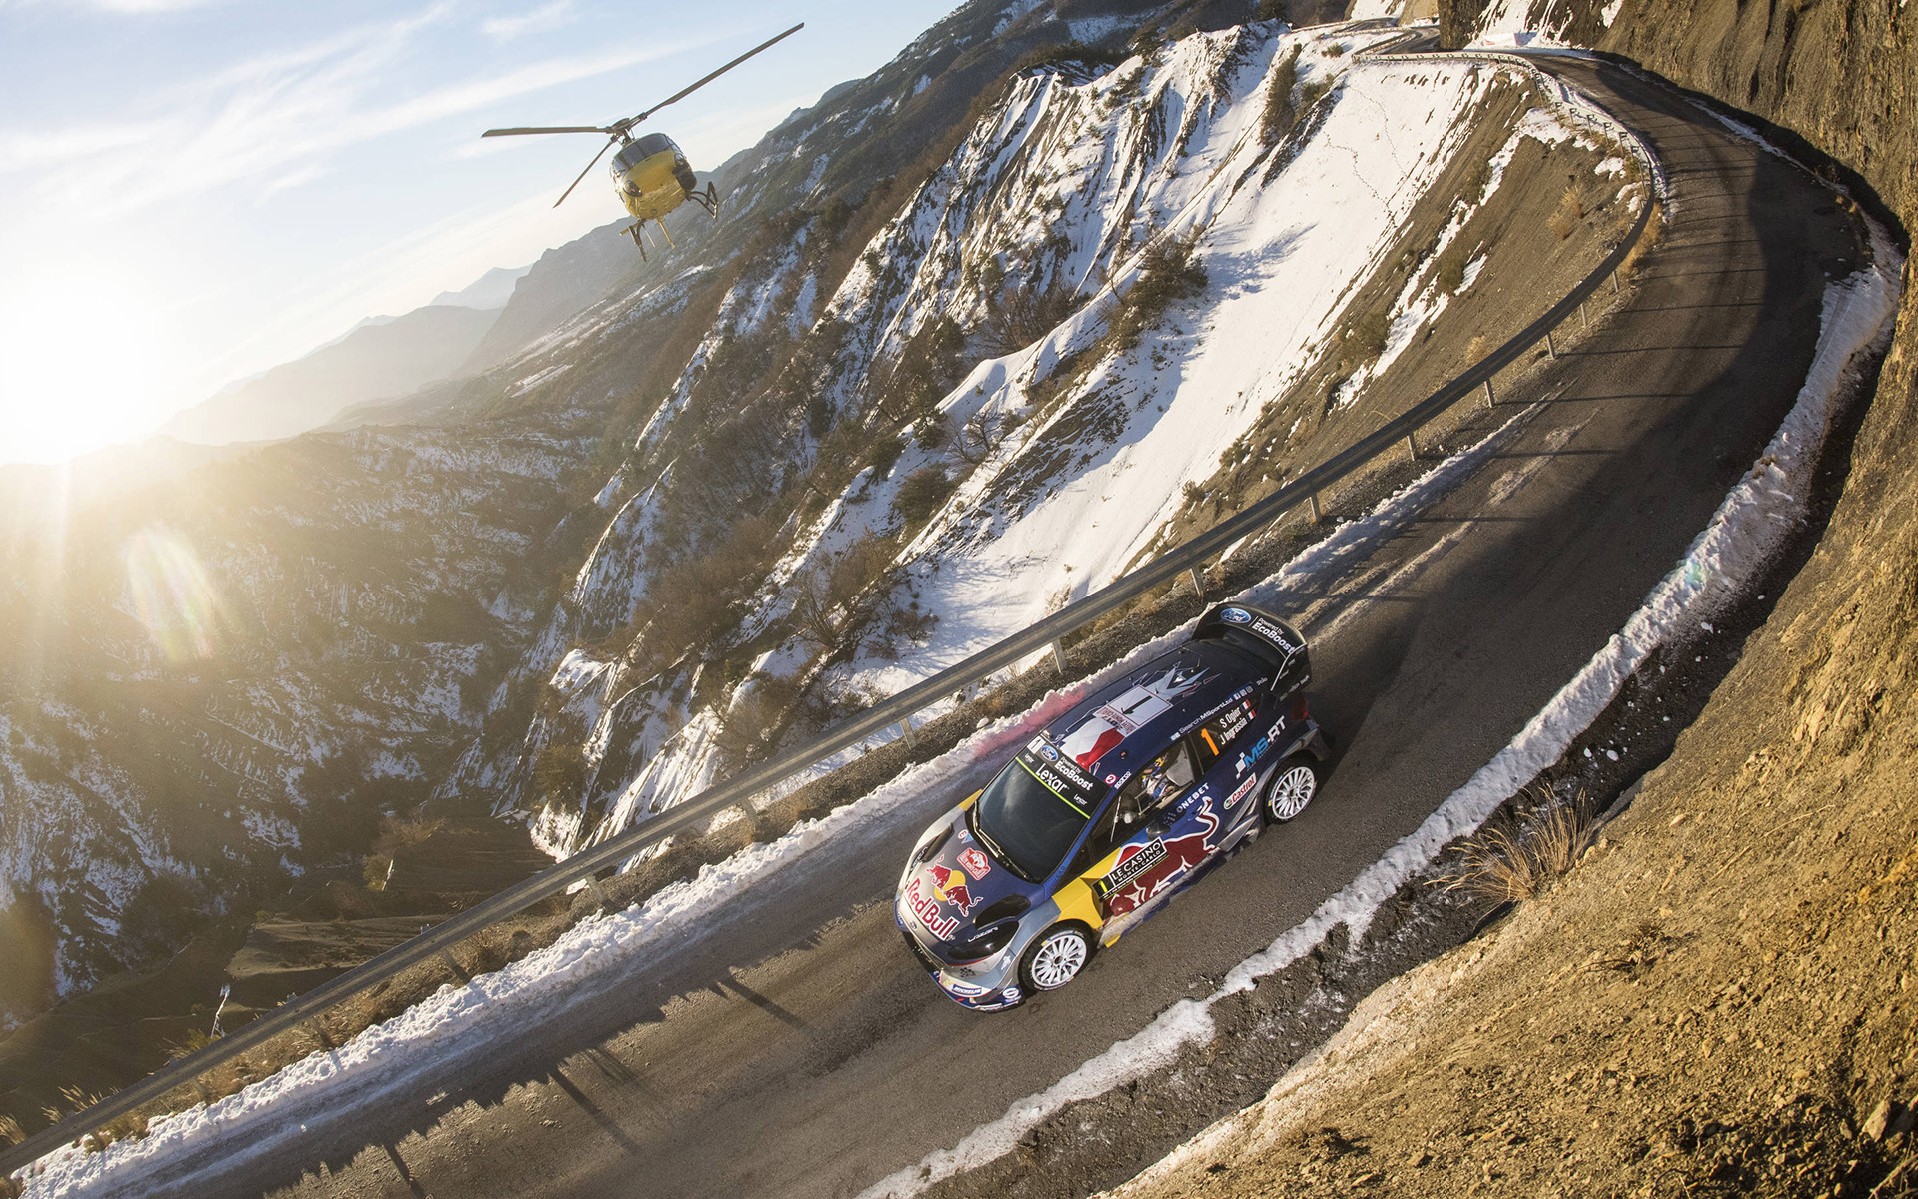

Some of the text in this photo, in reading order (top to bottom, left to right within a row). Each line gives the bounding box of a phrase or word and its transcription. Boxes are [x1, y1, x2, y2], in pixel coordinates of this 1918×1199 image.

[1252, 622, 1296, 654] EcoBoost
[1258, 617, 1278, 632] Powered
[1219, 705, 1241, 728] S Ogier
[1225, 717, 1248, 741] Ingrassia
[1200, 728, 1220, 756] 1
[1243, 715, 1288, 769] MS-RT
[1035, 762, 1068, 793] Lexar
[1054, 760, 1094, 791] EcoBoost
[1061, 756, 1077, 771] Powered
[1176, 782, 1211, 813] ONEBET
[1231, 775, 1255, 803] Castrol
[1112, 869, 1124, 881] LE
[1123, 842, 1161, 872] CASINO
[906, 877, 933, 915] Red
[921, 902, 959, 940] Bull
